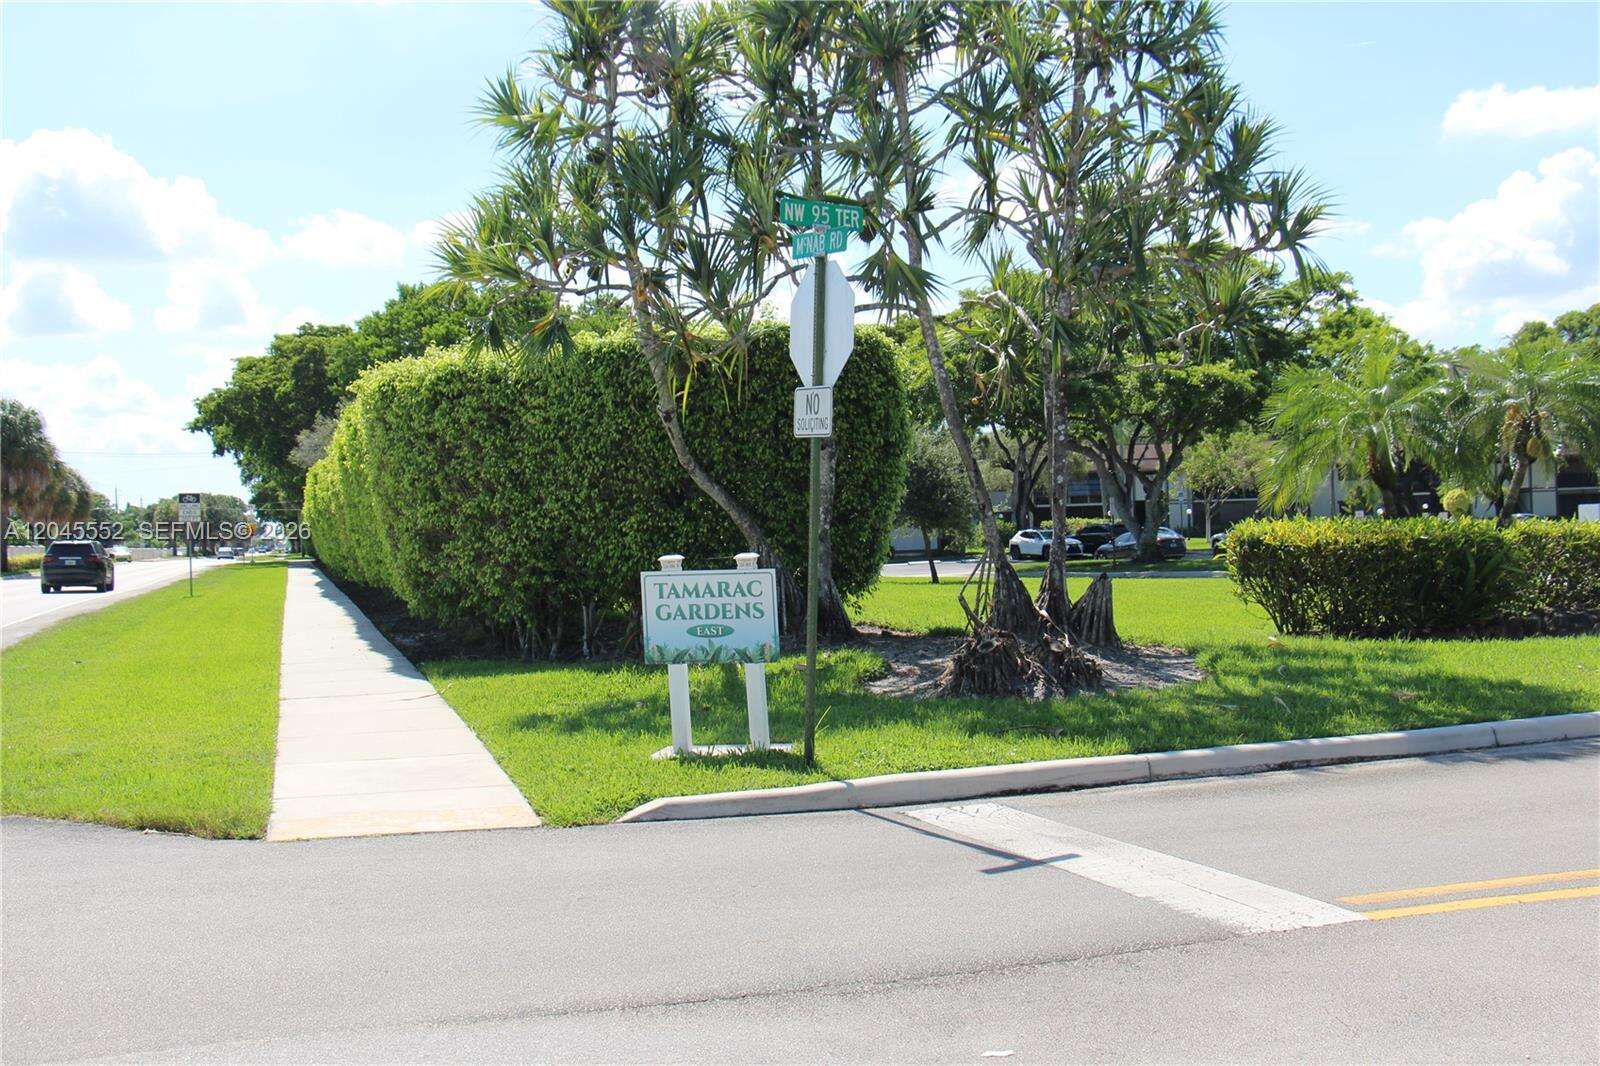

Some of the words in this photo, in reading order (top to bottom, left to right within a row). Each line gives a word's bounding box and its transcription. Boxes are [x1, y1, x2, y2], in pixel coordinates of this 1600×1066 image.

[784, 202, 805, 222] NW
[811, 205, 830, 225] 95
[835, 208, 860, 228] TER
[829, 230, 843, 251] RD
[805, 393, 820, 415] NO
[796, 416, 829, 431] SOLICITING
[653, 580, 763, 599] TAMARAC
[655, 602, 765, 621] GARDENS
[696, 626, 724, 637] EAST
